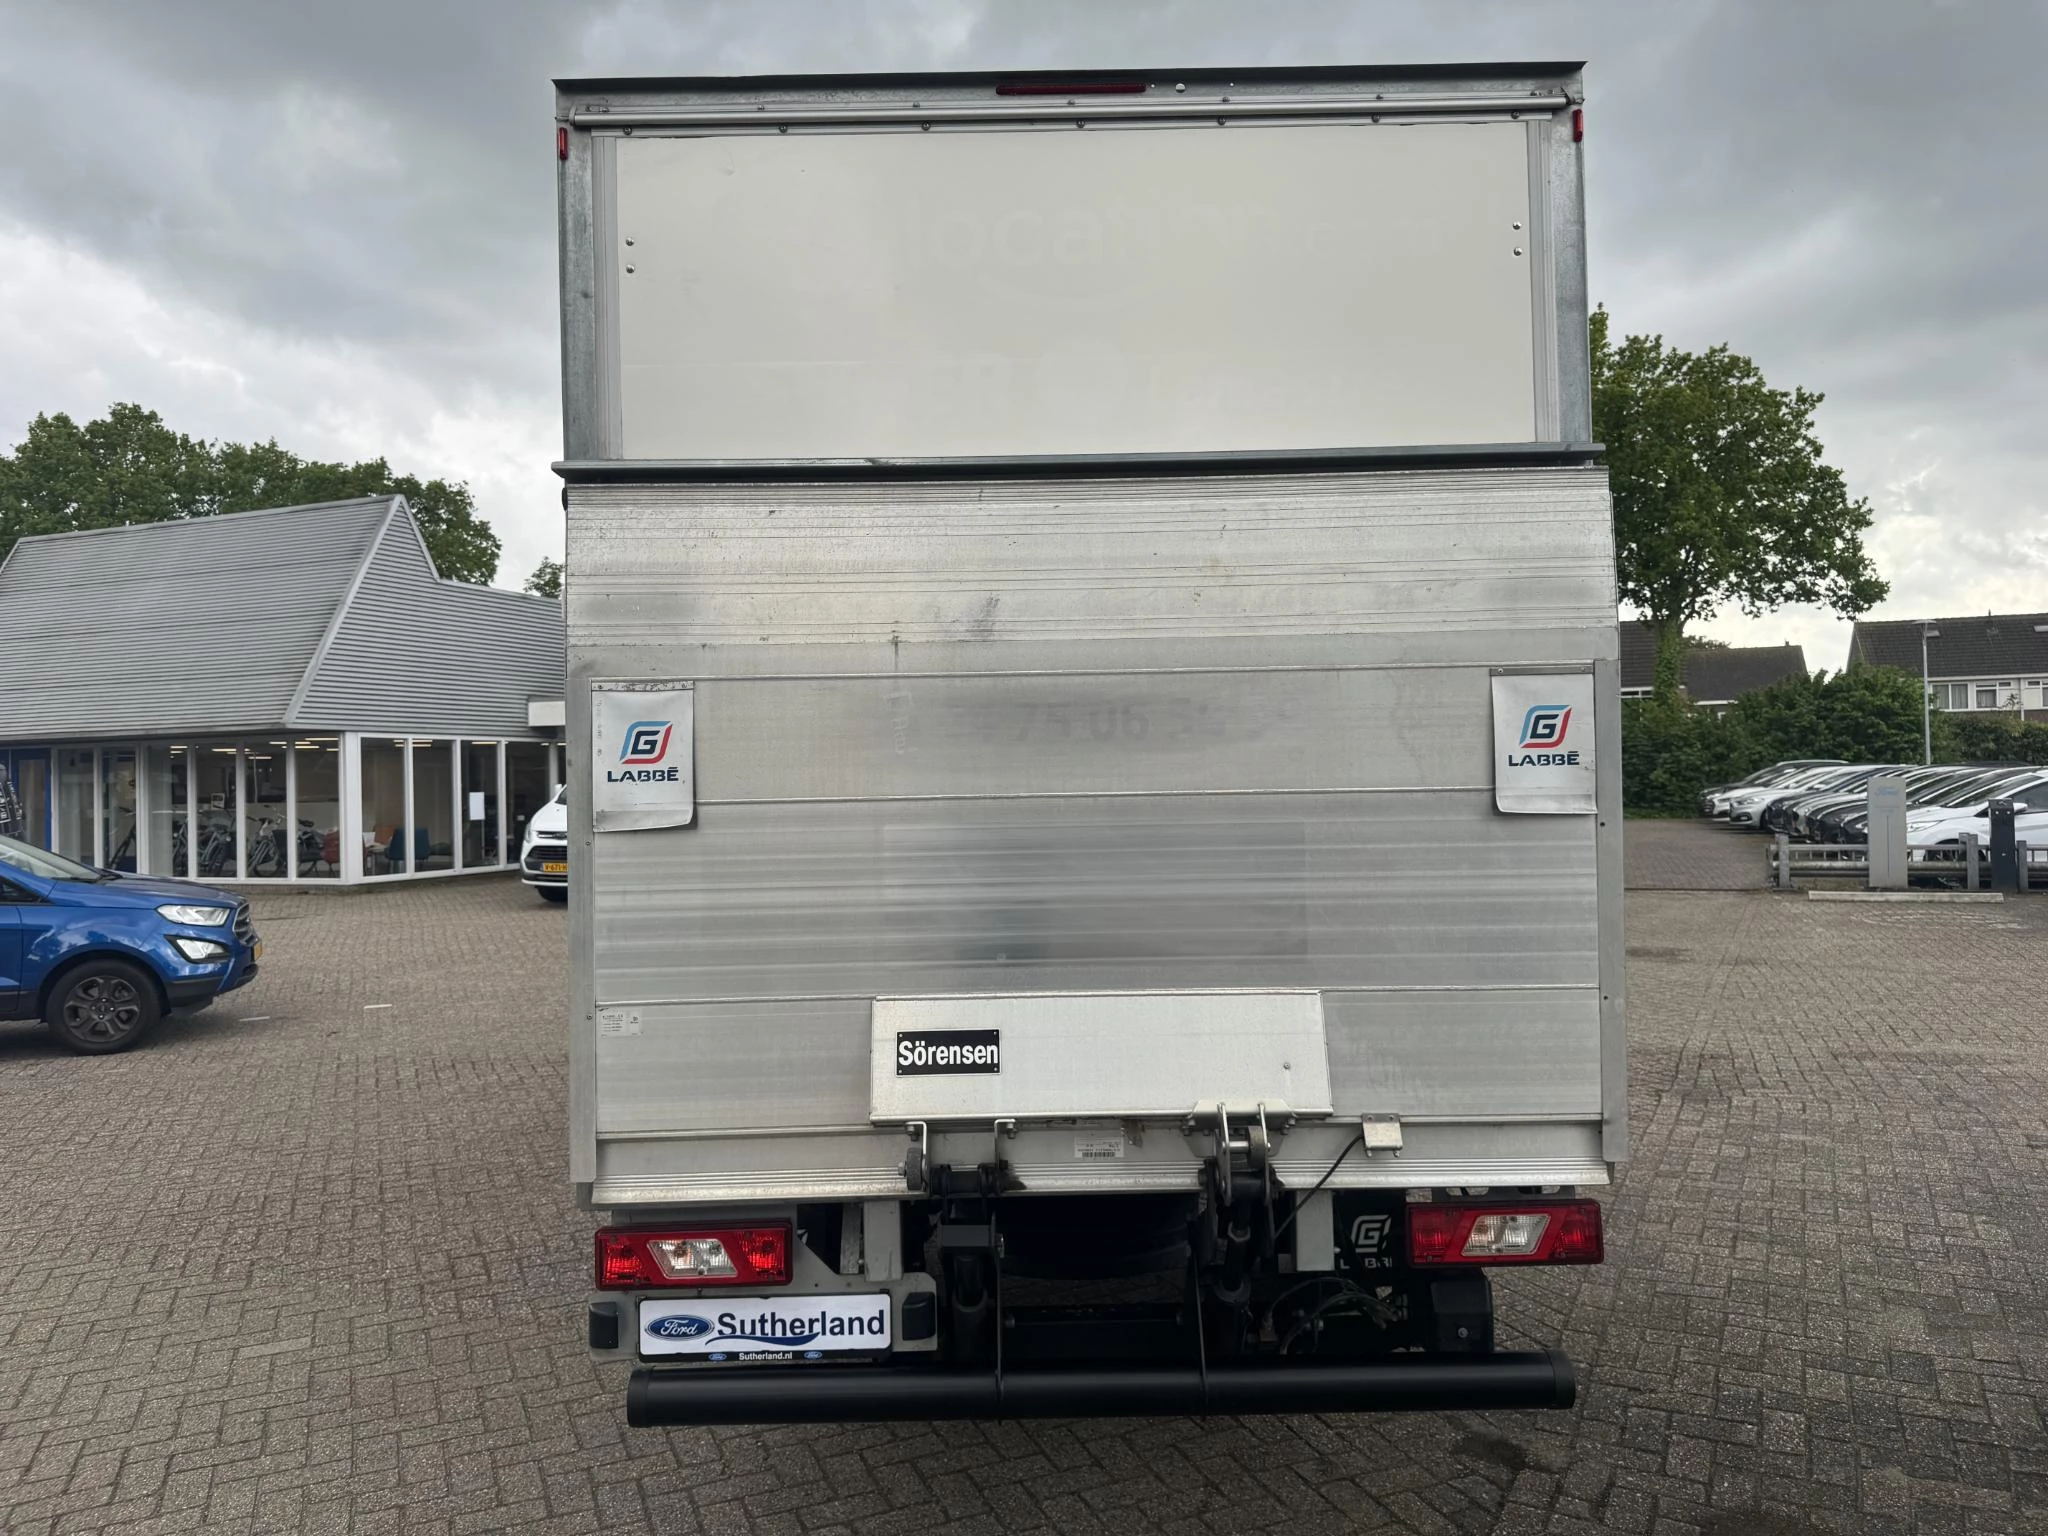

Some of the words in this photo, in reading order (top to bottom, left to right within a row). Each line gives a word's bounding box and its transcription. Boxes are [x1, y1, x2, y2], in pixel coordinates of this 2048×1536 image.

[898, 1040, 999, 1066] Sörensen
[660, 1318, 699, 1336] Ford
[717, 1309, 885, 1338] Sutherland
[738, 1351, 793, 1361] Sutherland.nl
